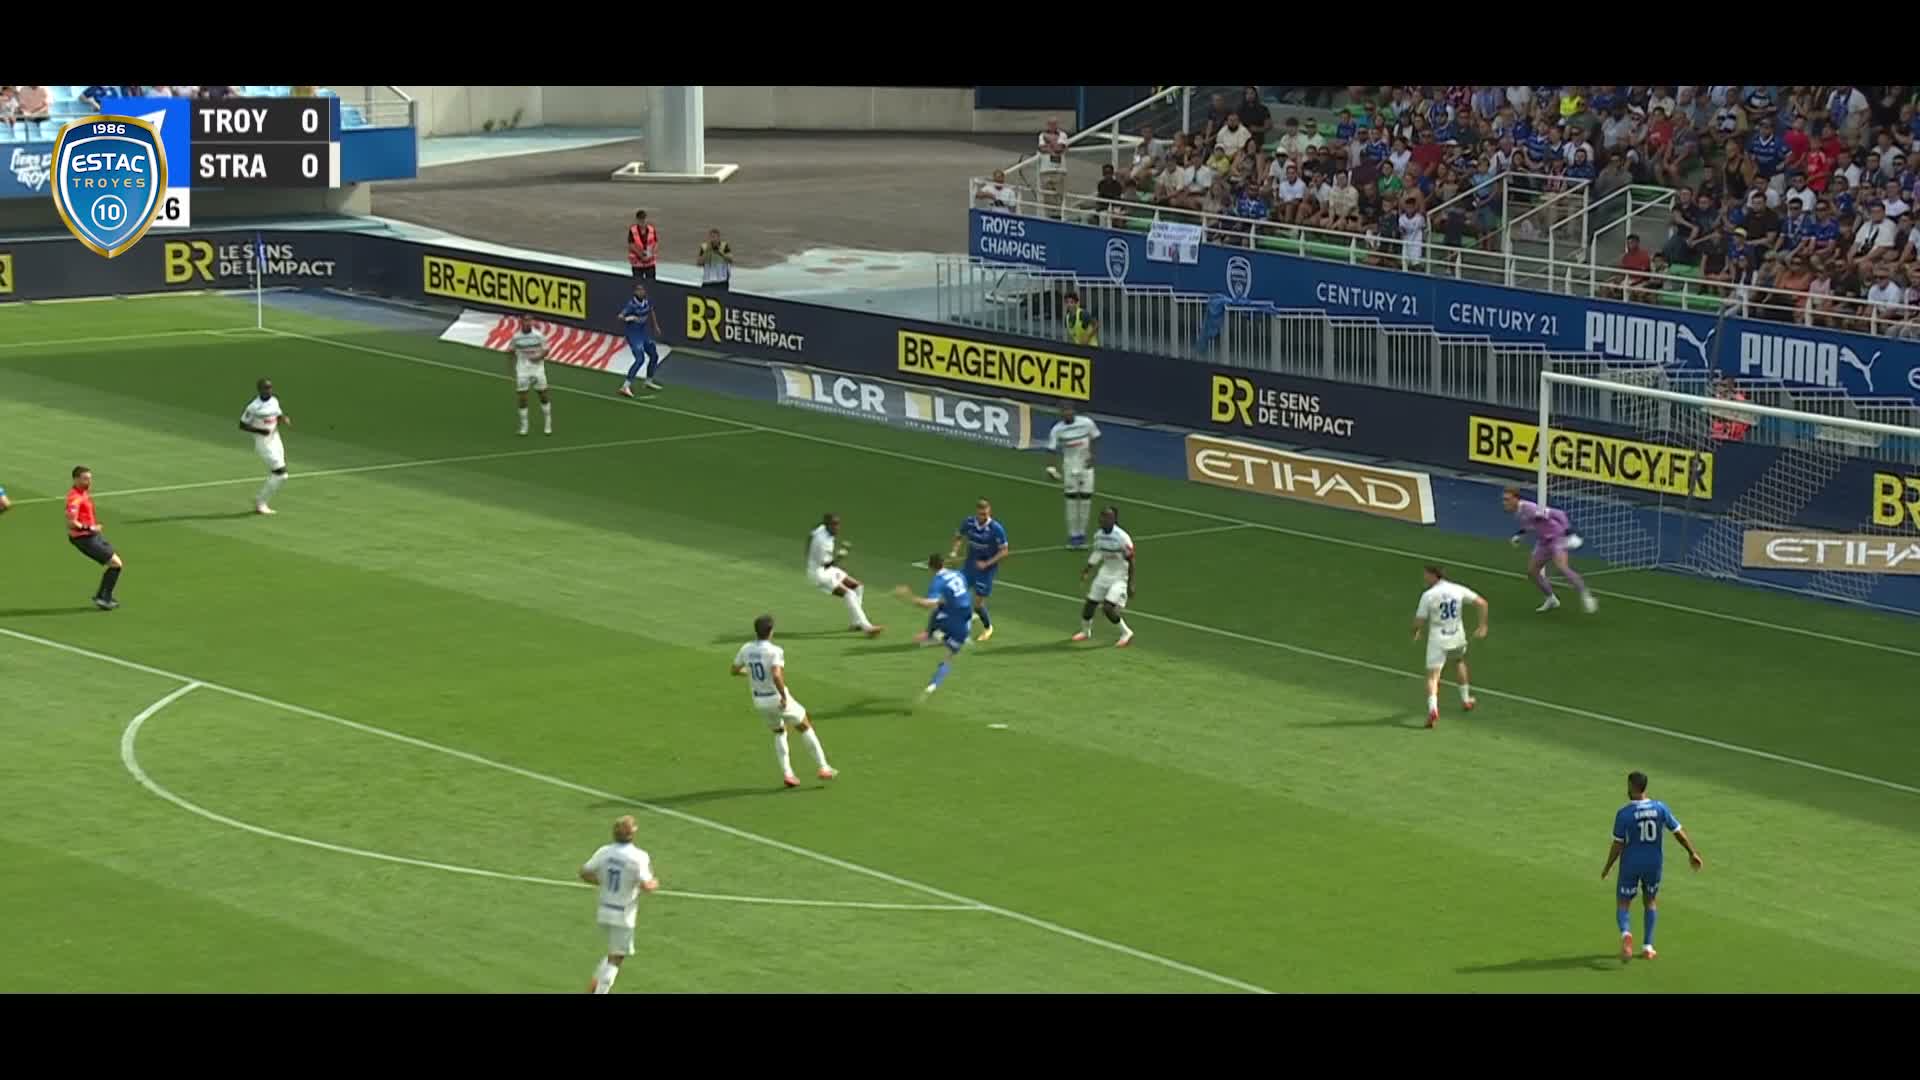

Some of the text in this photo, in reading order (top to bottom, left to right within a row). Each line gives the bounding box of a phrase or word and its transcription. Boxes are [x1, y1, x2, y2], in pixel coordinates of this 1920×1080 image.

[980, 214, 1026, 237] TROYES
[164, 240, 215, 284] BR
[219, 245, 240, 260] LE
[980, 236, 1047, 262] CHAMPAGNE
[220, 261, 242, 275] DE
[428, 260, 583, 311] BR-AGENCY.FR
[1316, 281, 1418, 315] CENTURY 21
[686, 295, 722, 343] BR
[724, 307, 777, 330] LE SENS
[1449, 302, 1558, 336] CENTURY 21
[724, 325, 805, 352] DE L'IMPACT
[1585, 310, 1677, 364] PUMA
[904, 335, 1087, 395] BR-AGENCY.FR
[1740, 331, 1838, 388] PUMA
[811, 373, 887, 415] LCR
[1211, 374, 1255, 427] BR
[1258, 388, 1320, 413] LE SENS
[934, 396, 1010, 436] LCR
[1258, 407, 1355, 438] DE L'IMPACT
[1195, 448, 1411, 511] ETIHAD
[748, 662, 765, 682] 10
[1637, 819, 1657, 843] 10
[607, 867, 621, 894] 11
